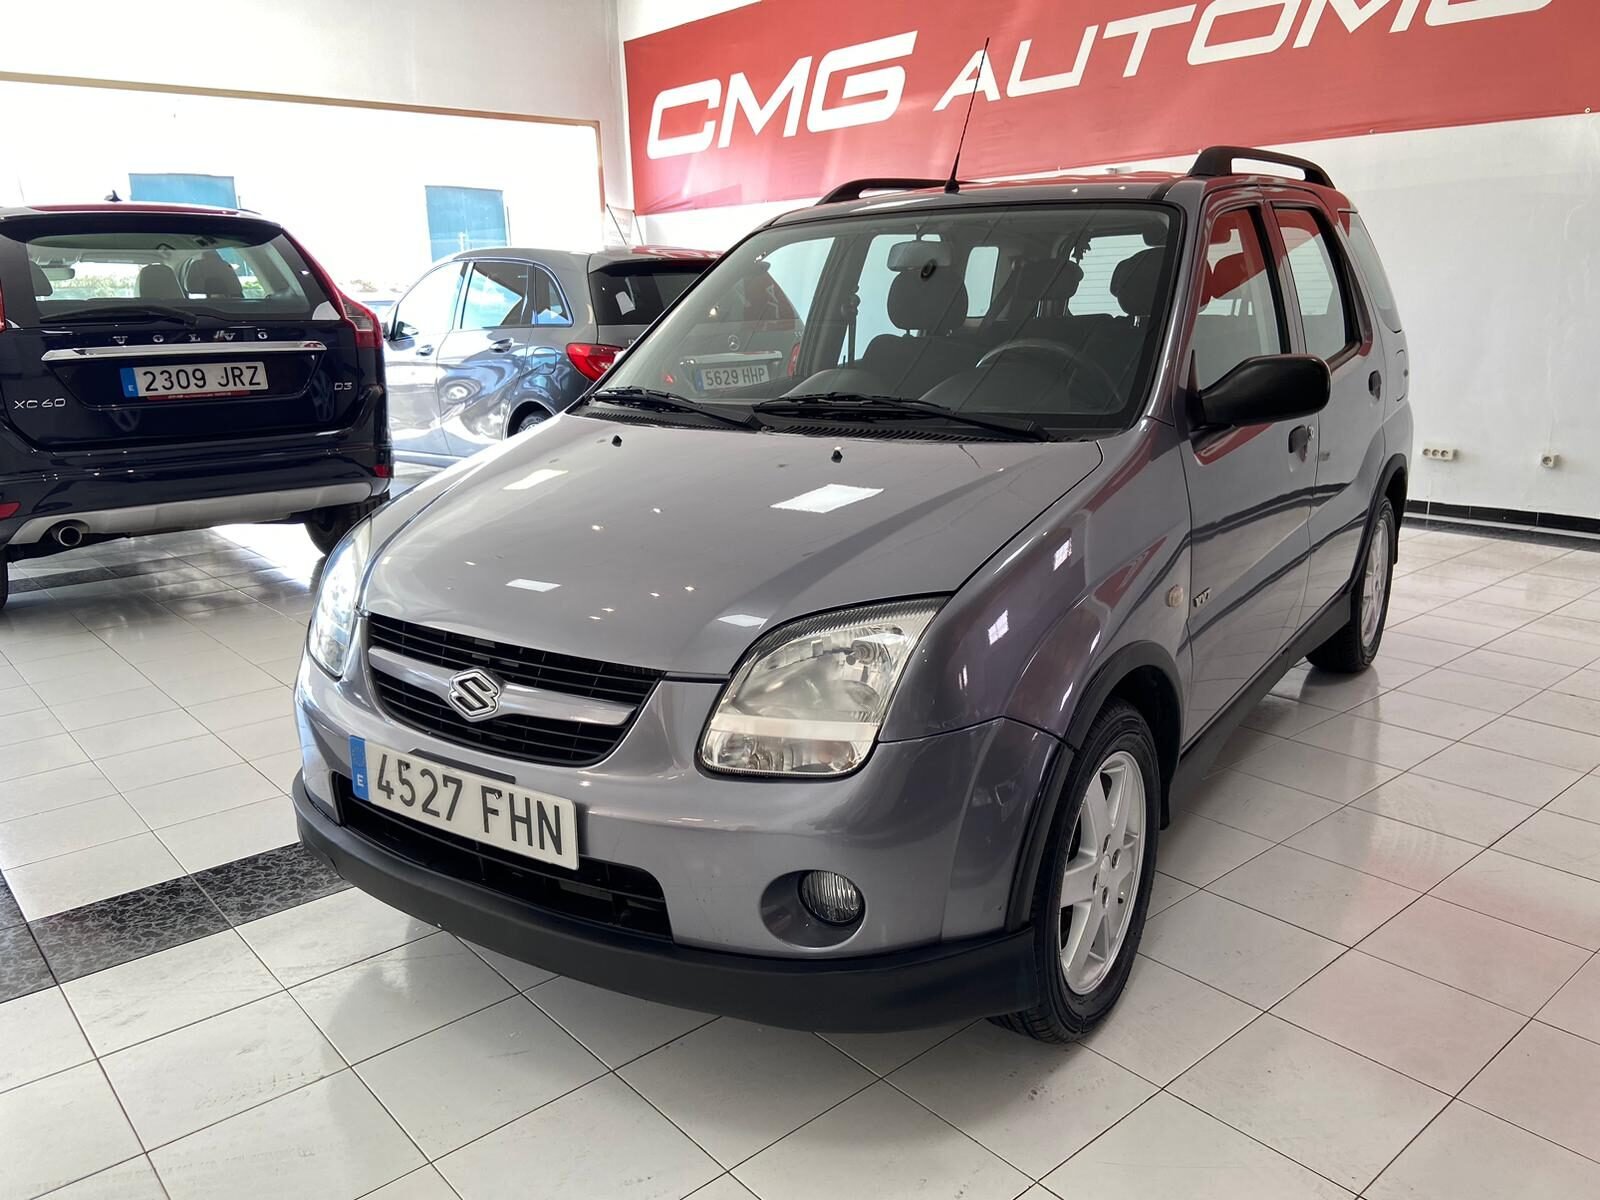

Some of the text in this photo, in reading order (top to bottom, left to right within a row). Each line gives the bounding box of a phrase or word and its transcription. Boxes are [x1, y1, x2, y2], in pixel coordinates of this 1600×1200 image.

[646, 30, 918, 160] CMG
[143, 365, 261, 392] 2309 JRZ
[334, 382, 353, 391] D3
[705, 367, 765, 386] 5629 HHP
[356, 774, 365, 787] E
[376, 754, 563, 856] 4527 FHN
